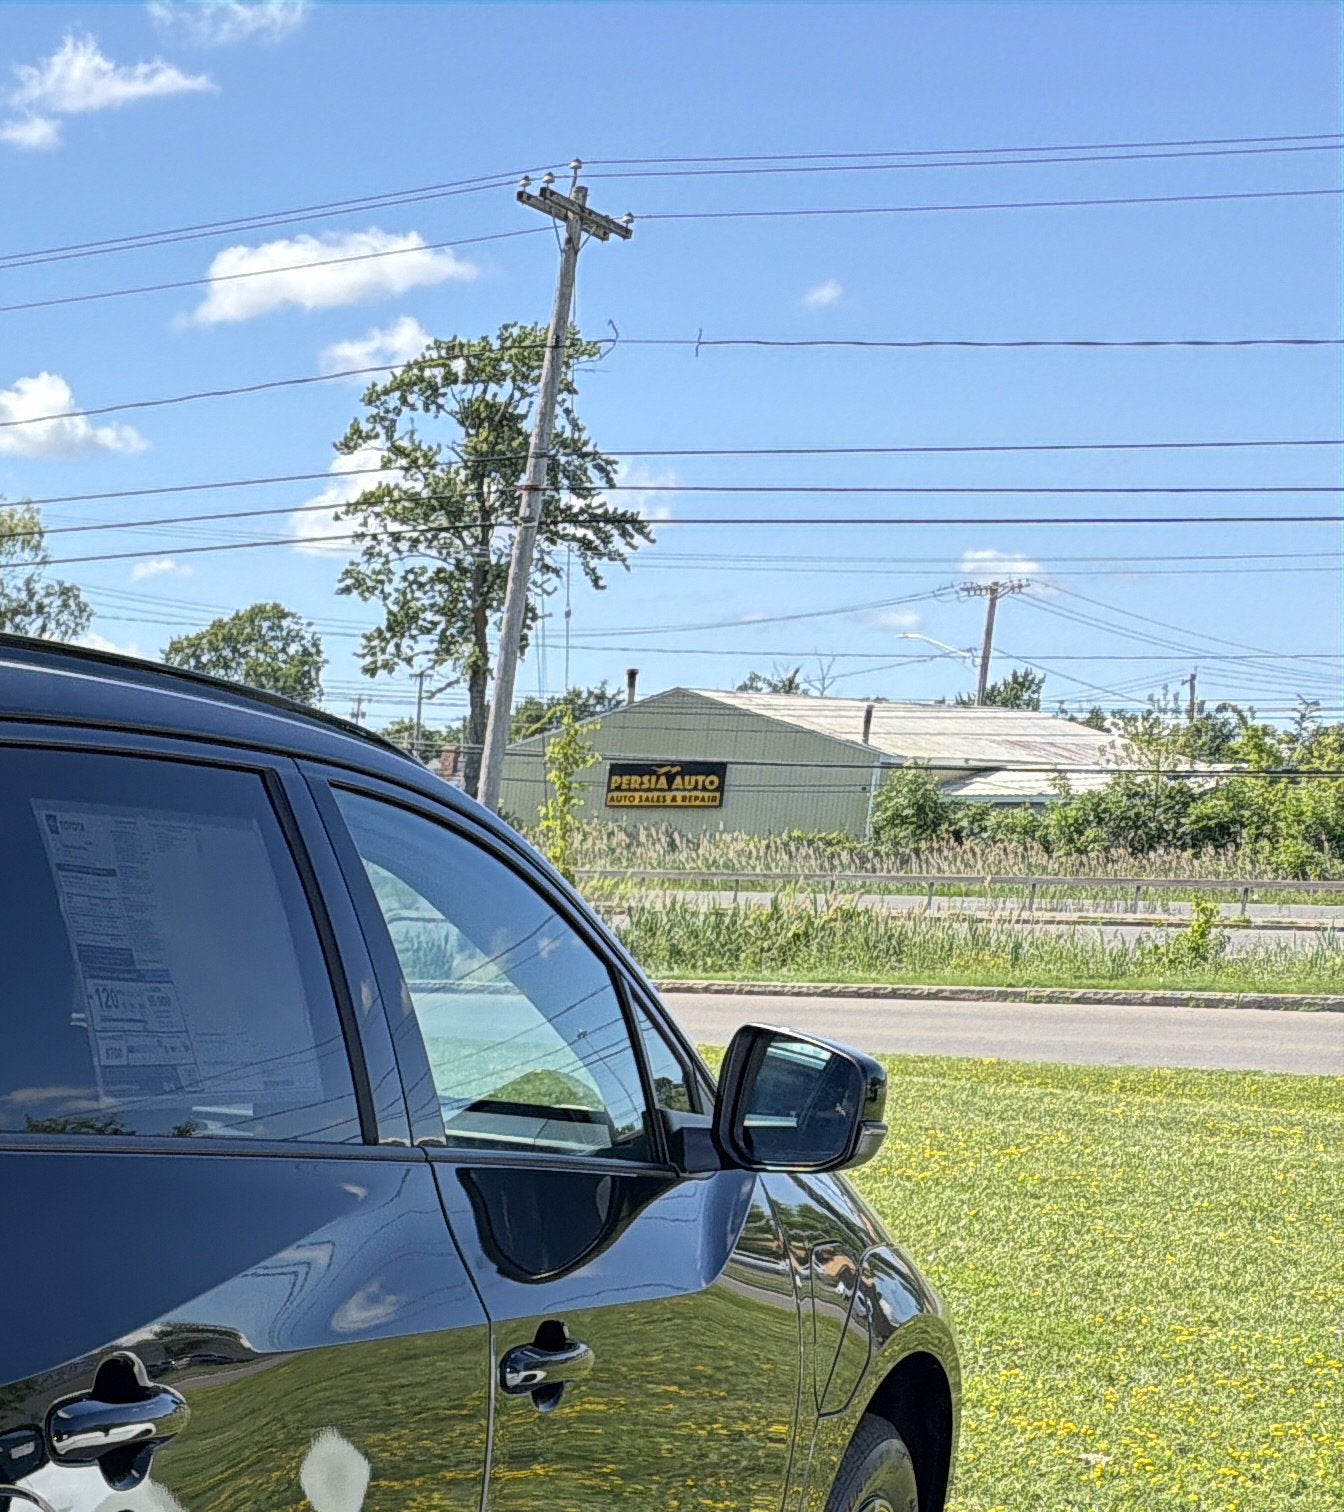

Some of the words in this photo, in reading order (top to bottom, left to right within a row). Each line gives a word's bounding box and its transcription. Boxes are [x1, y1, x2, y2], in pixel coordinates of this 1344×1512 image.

[610, 775, 668, 790] PERSIA
[671, 775, 720, 790] AUTO
[609, 794, 636, 804] AUTO
[638, 794, 667, 804] SALES
[681, 794, 718, 804] REPAIR
